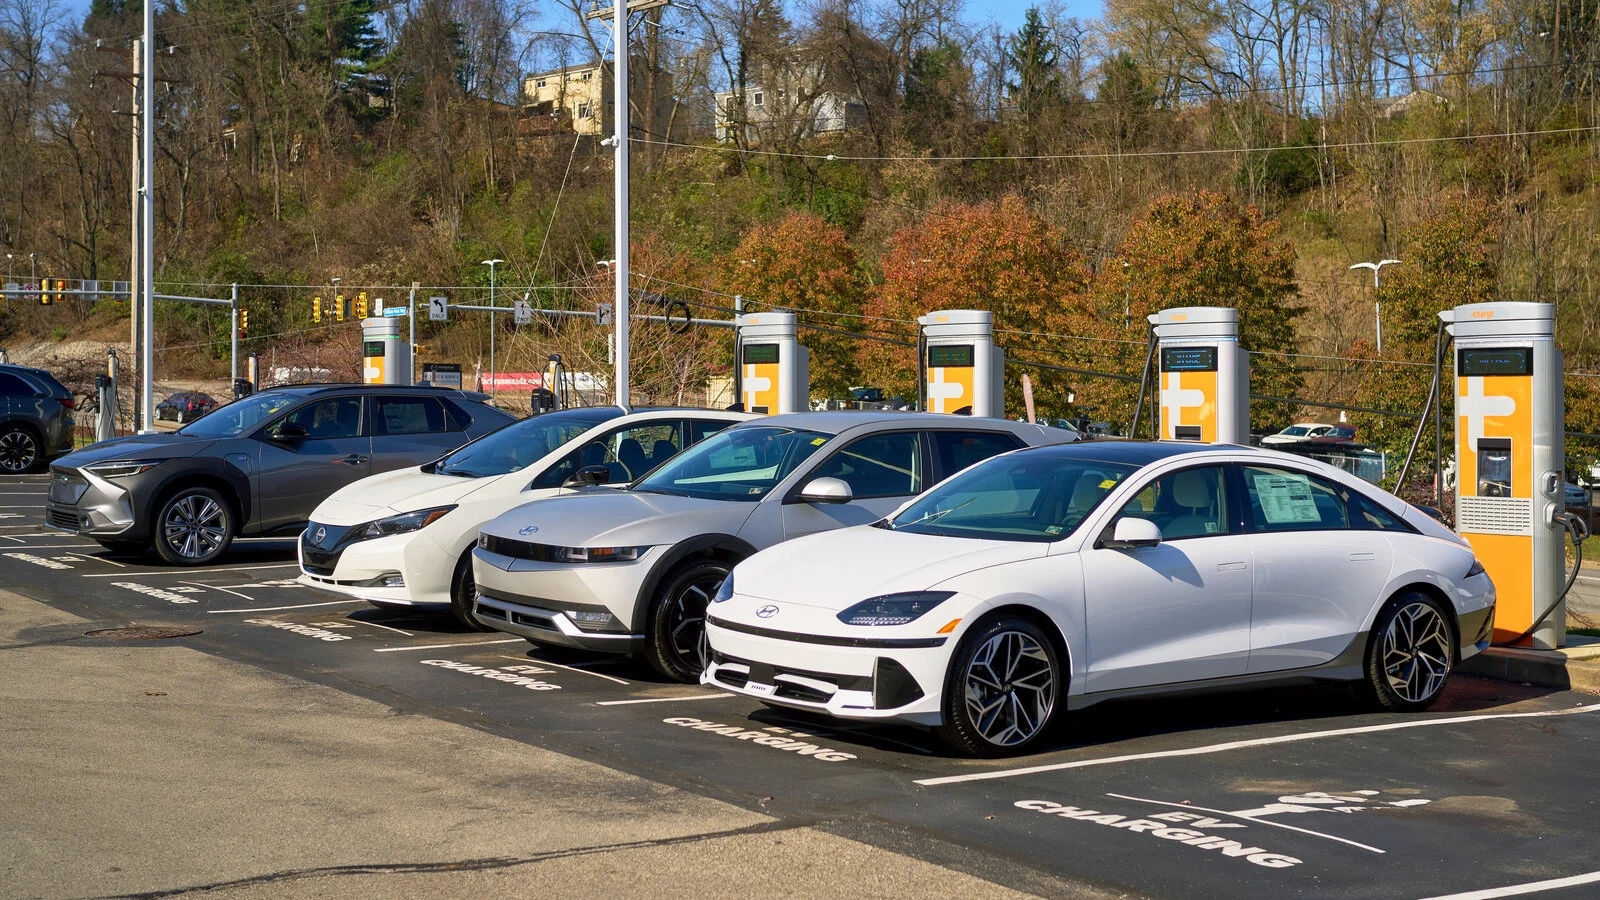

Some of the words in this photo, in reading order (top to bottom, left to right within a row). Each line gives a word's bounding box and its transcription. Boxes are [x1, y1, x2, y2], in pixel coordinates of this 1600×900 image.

[419, 659, 563, 691] CHARGING
[499, 664, 557, 674] EV
[662, 717, 858, 762] CHARGING
[1013, 799, 1304, 869] CHARGING
[1146, 811, 1249, 829] EV
